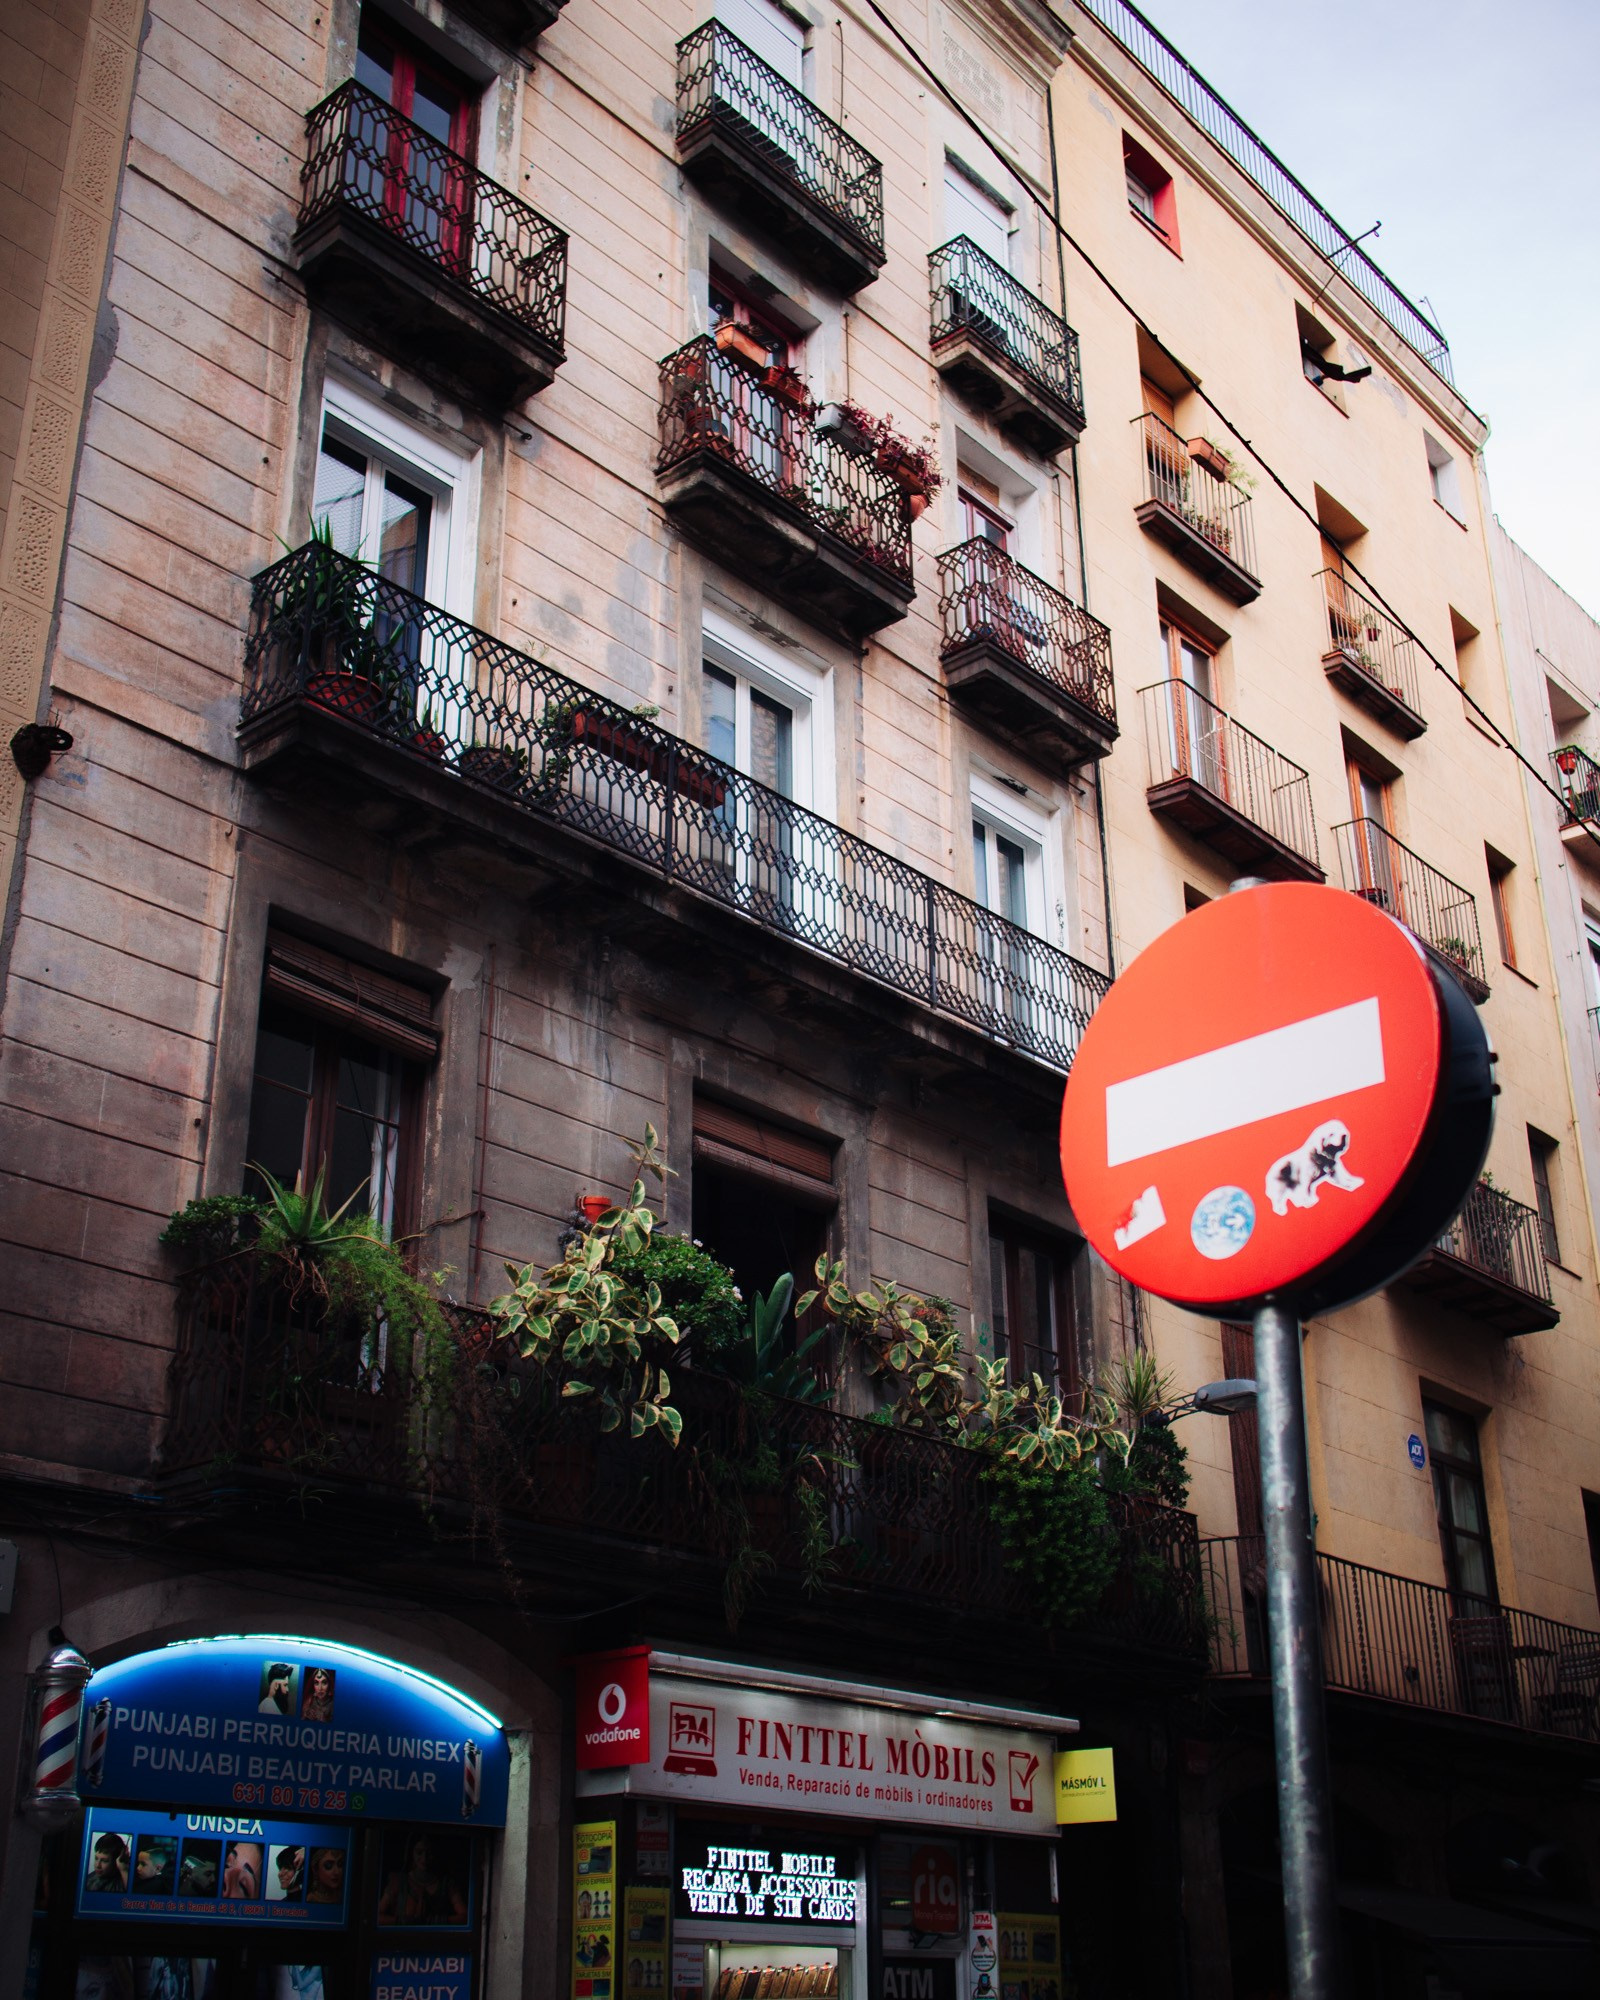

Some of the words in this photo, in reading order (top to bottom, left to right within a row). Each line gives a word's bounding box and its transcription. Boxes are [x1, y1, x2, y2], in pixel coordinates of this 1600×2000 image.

[114, 1707, 217, 1740] PUNJABI
[222, 1719, 382, 1756] PERRUQUERIA
[387, 1735, 461, 1763] UNISEX
[585, 1726, 641, 1745] vodafone
[736, 1717, 874, 1771] FINTTEL
[885, 1729, 996, 1787] MÒBILS
[131, 1745, 241, 1777] PUNJABI
[247, 1756, 344, 1785] BEAUTY
[348, 1765, 437, 1793] PARLAR
[233, 1781, 266, 1804] 631
[271, 1785, 294, 1806] 80
[298, 1787, 320, 1808] 76
[323, 1789, 347, 1810] 25
[739, 1768, 783, 1792] Venda,
[787, 1774, 851, 1796] Reparació
[856, 1782, 870, 1798] de
[875, 1785, 913, 1803] mòbils
[918, 1789, 921, 1804] i
[926, 1792, 993, 1812] ordinadores
[187, 1814, 264, 1836] UNISEX
[707, 1846, 774, 1873] FINTTEL
[781, 1853, 836, 1878] MOBILE
[682, 1868, 751, 1894] RECARGA
[758, 1874, 857, 1901] ACCESSORIES
[914, 1858, 957, 1907] ria
[688, 1890, 739, 1915] VENTA
[744, 1893, 765, 1917] DE
[773, 1896, 803, 1919] SIM
[808, 1898, 854, 1922] CARDS
[376, 1957, 465, 1974] PUNJABI
[376, 1986, 460, 2000] BEAUTY
[883, 1966, 934, 2000] ATM
